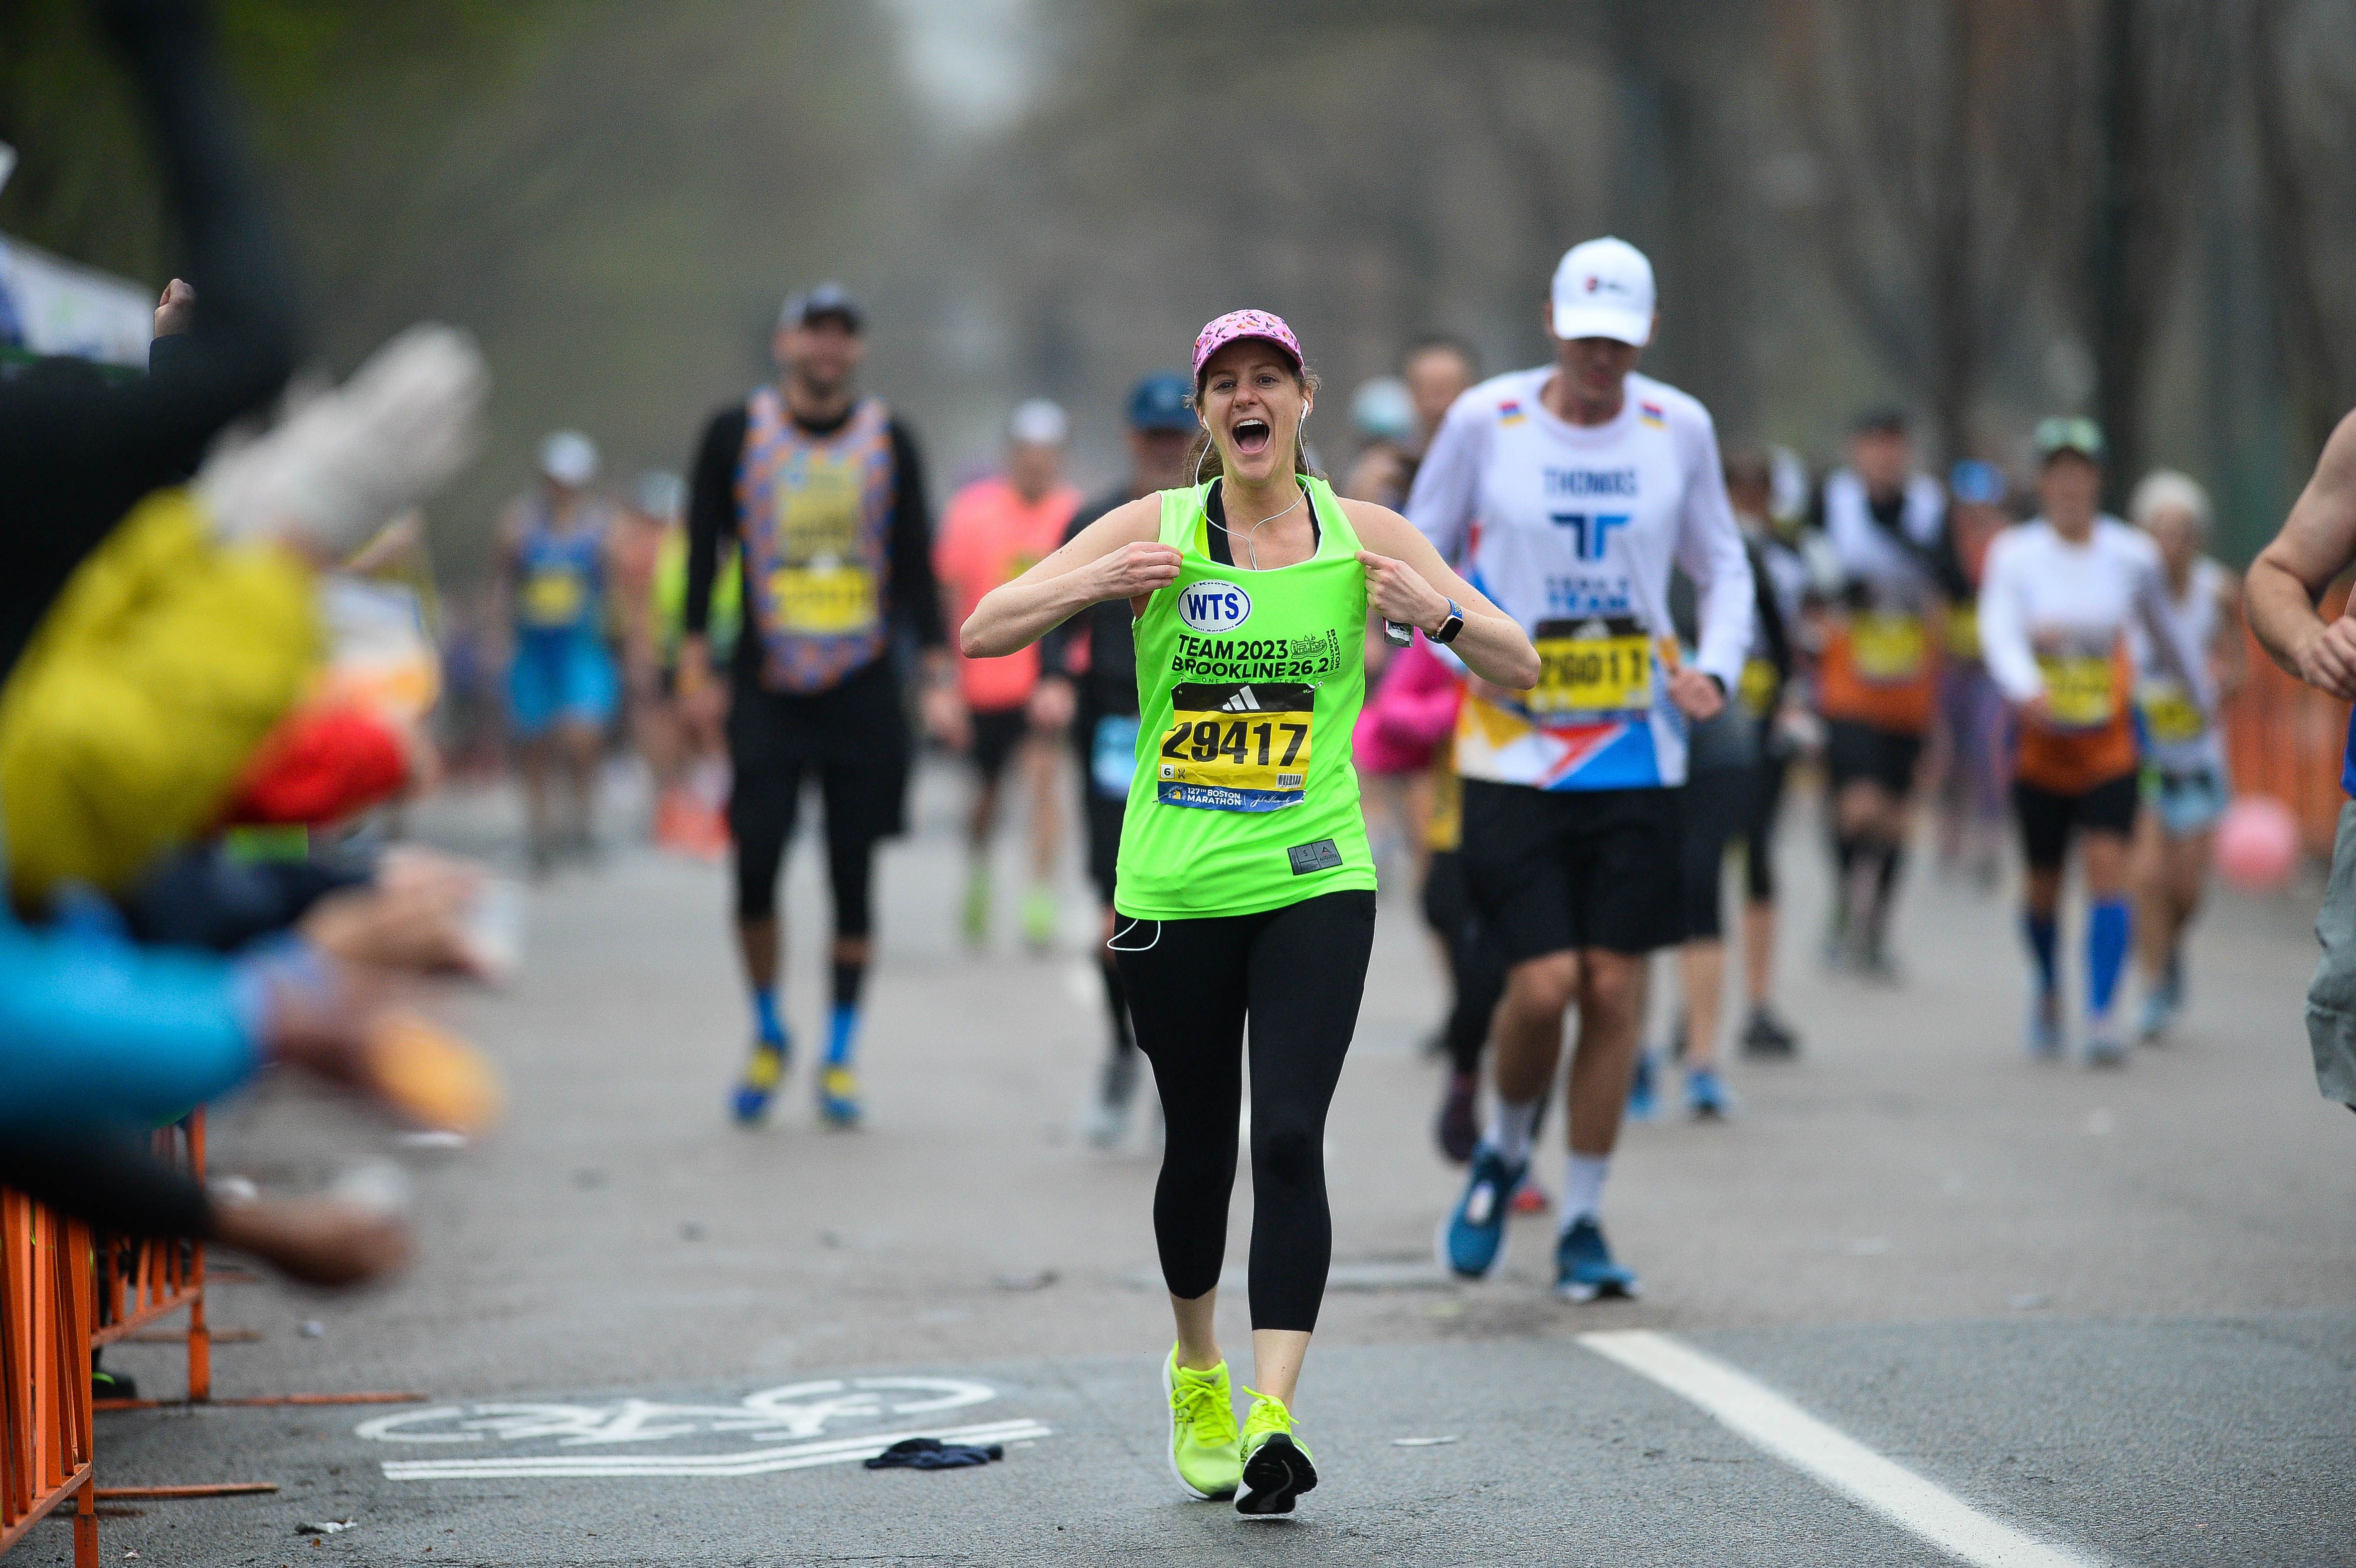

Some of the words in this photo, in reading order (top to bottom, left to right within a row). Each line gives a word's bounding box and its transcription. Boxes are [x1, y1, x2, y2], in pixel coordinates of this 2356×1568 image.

[1187, 593, 1239, 620] WTS
[1178, 633, 1234, 660] TEAM
[1236, 639, 1288, 661] 2023
[1330, 629, 1340, 669] BOSTON
[1171, 655, 1286, 679] BROOKLINE
[1287, 657, 1329, 676] 26.2
[1162, 721, 1308, 767] 29417
[1187, 795, 1241, 806] MARATHON
[1208, 789, 1241, 799] BOSTON
